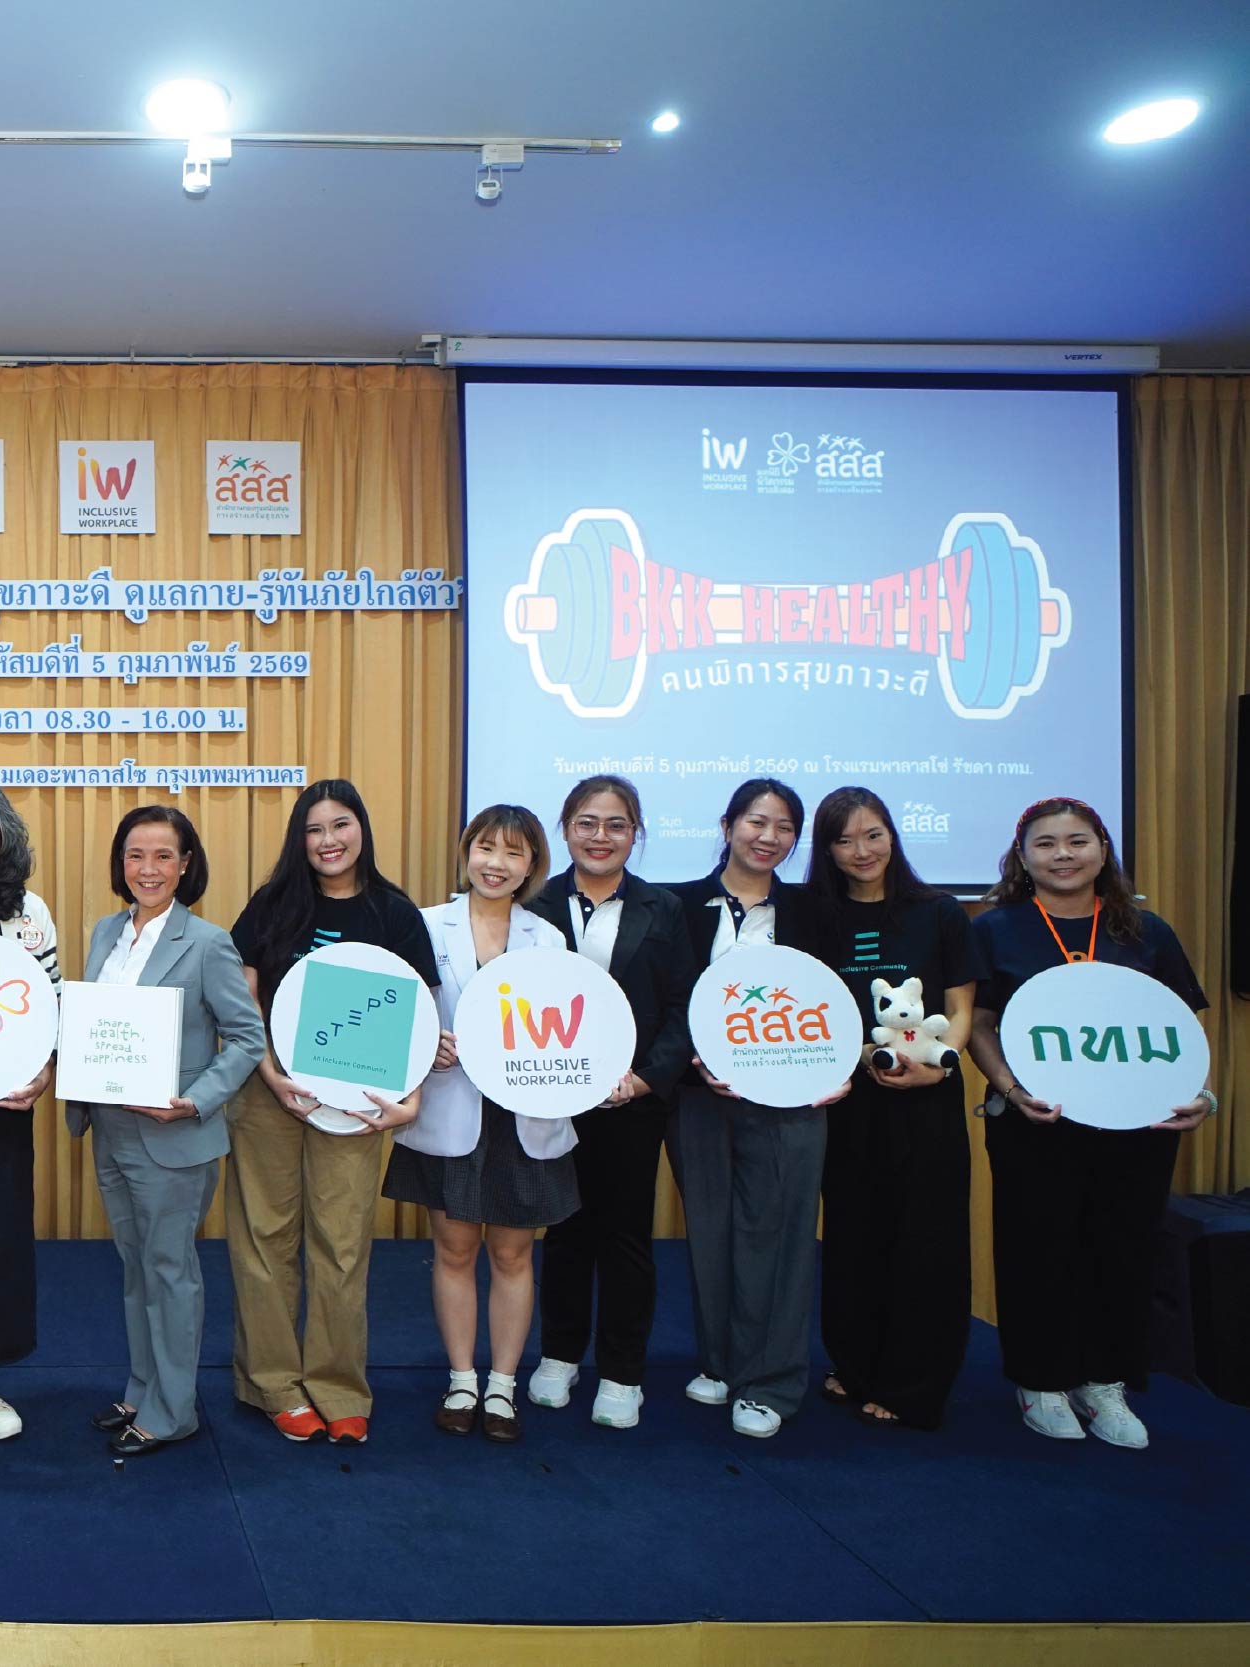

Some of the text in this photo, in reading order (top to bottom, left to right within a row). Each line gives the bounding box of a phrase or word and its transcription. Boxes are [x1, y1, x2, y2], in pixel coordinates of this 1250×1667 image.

[1063, 353, 1103, 361] VERTEX
[815, 451, 885, 478] สสส
[215, 473, 292, 502] สสส
[78, 507, 138, 516] INCLUSIVE
[78, 518, 139, 528] WORKPLACE
[611, 544, 974, 663] BKK HEALTHY
[93, 654, 105, 673] 5
[118, 643, 239, 683] กุมภาพันธ์
[250, 654, 308, 673] 2569
[661, 659, 930, 697] คนพิการสุขภาวะดี
[45, 710, 111, 729] 08.30
[142, 710, 206, 729] 16.00
[218, 708, 245, 729] น.
[659, 758, 670, 773] 5
[755, 758, 799, 773] 2569
[998, 761, 1035, 775] กทม.
[157, 767, 304, 790] กรุงเทพมหานคร
[902, 813, 950, 833] สสส
[839, 963, 908, 973] Inclusive Community
[97, 1018, 131, 1029] Share
[725, 1002, 832, 1045] สสส
[89, 1027, 146, 1043] Health,
[1028, 1025, 1181, 1063] กทม
[322, 1056, 351, 1067] Inclusive
[352, 1061, 387, 1076] Community
[505, 1058, 591, 1073] INCLUSIVE
[506, 1073, 593, 1087] WORKPLACE
